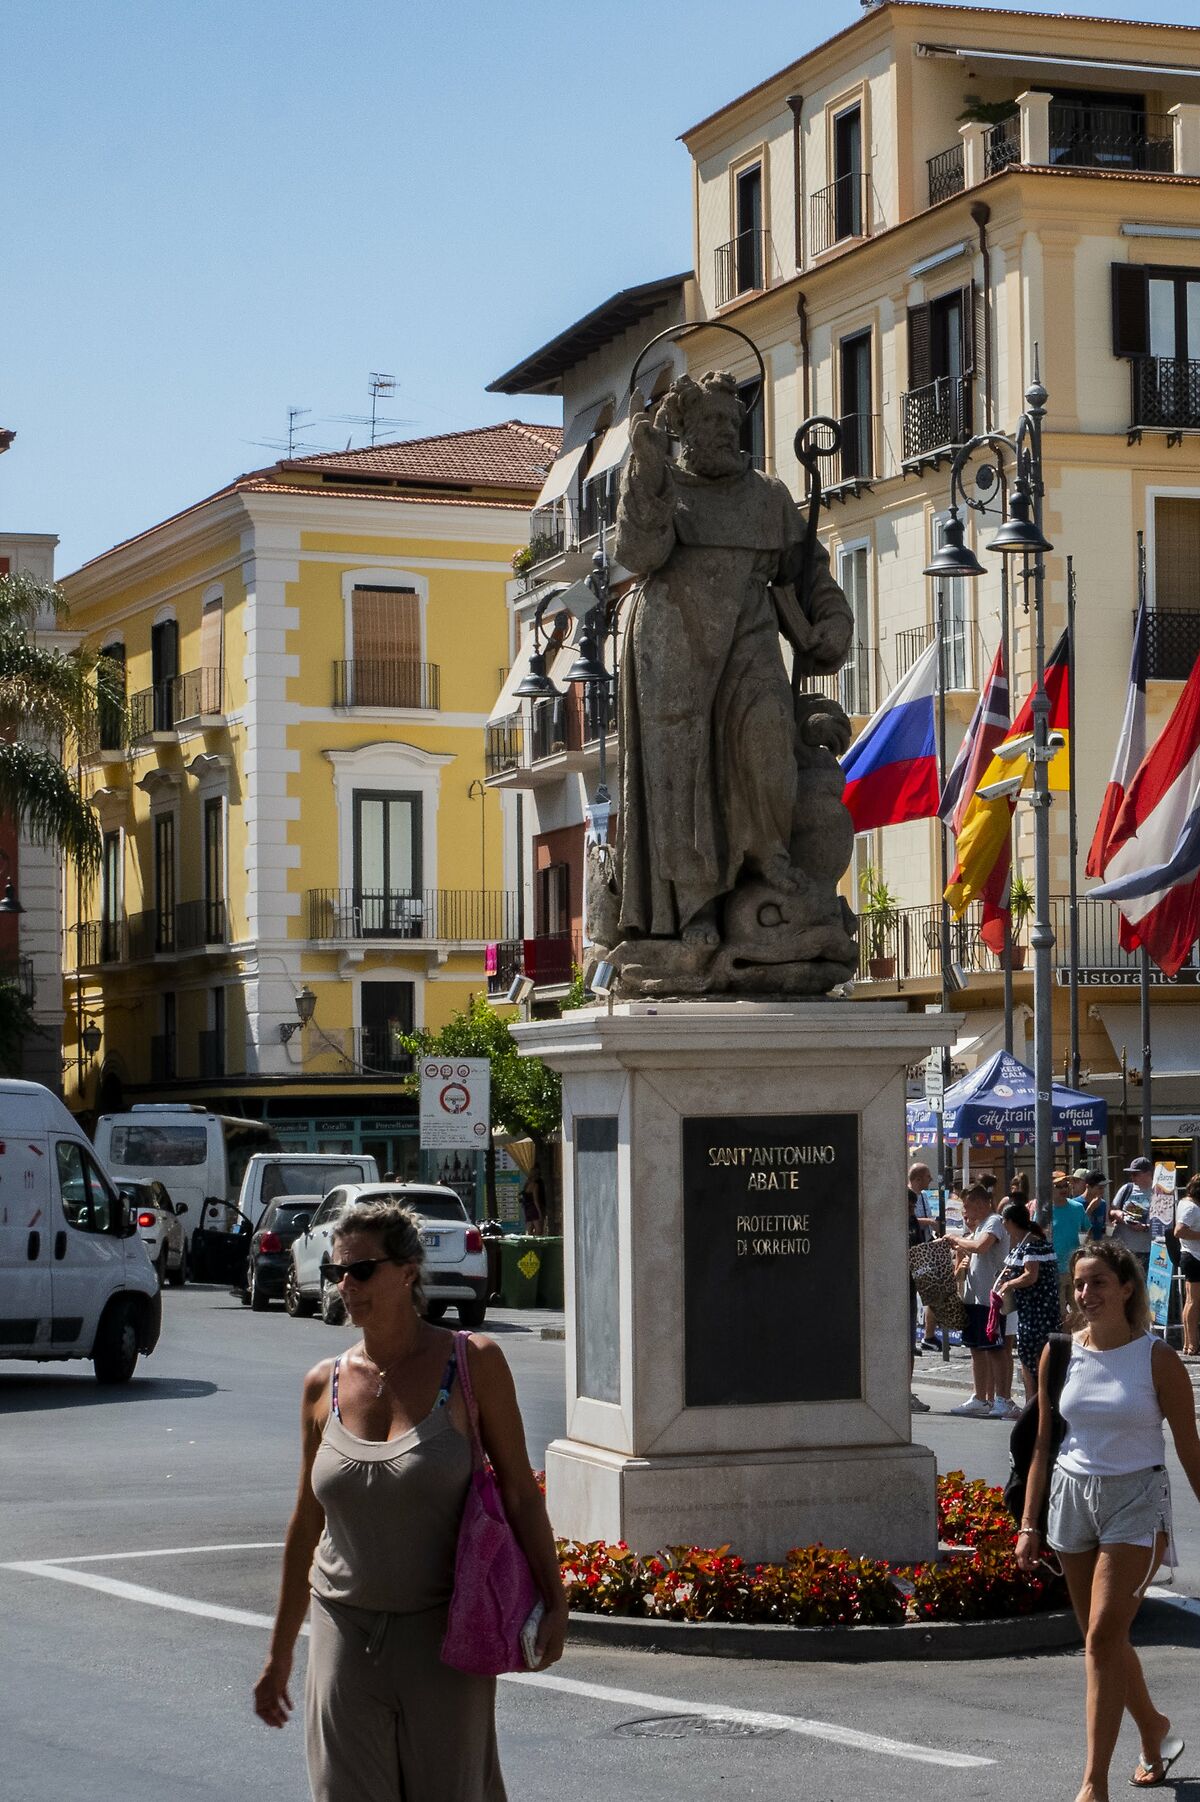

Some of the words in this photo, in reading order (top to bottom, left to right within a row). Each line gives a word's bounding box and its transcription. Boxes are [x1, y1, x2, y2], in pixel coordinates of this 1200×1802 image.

[1000, 1065, 1023, 1073] KEEP
[1059, 1109, 1093, 1119] official
[1072, 1117, 1094, 1127] tour
[708, 1145, 836, 1166] SANT'ANTONINO
[747, 1171, 800, 1190] ABATE
[737, 1214, 811, 1232] PROTETTORE
[737, 1239, 748, 1256] DI
[752, 1238, 811, 1256] SORRENTO
